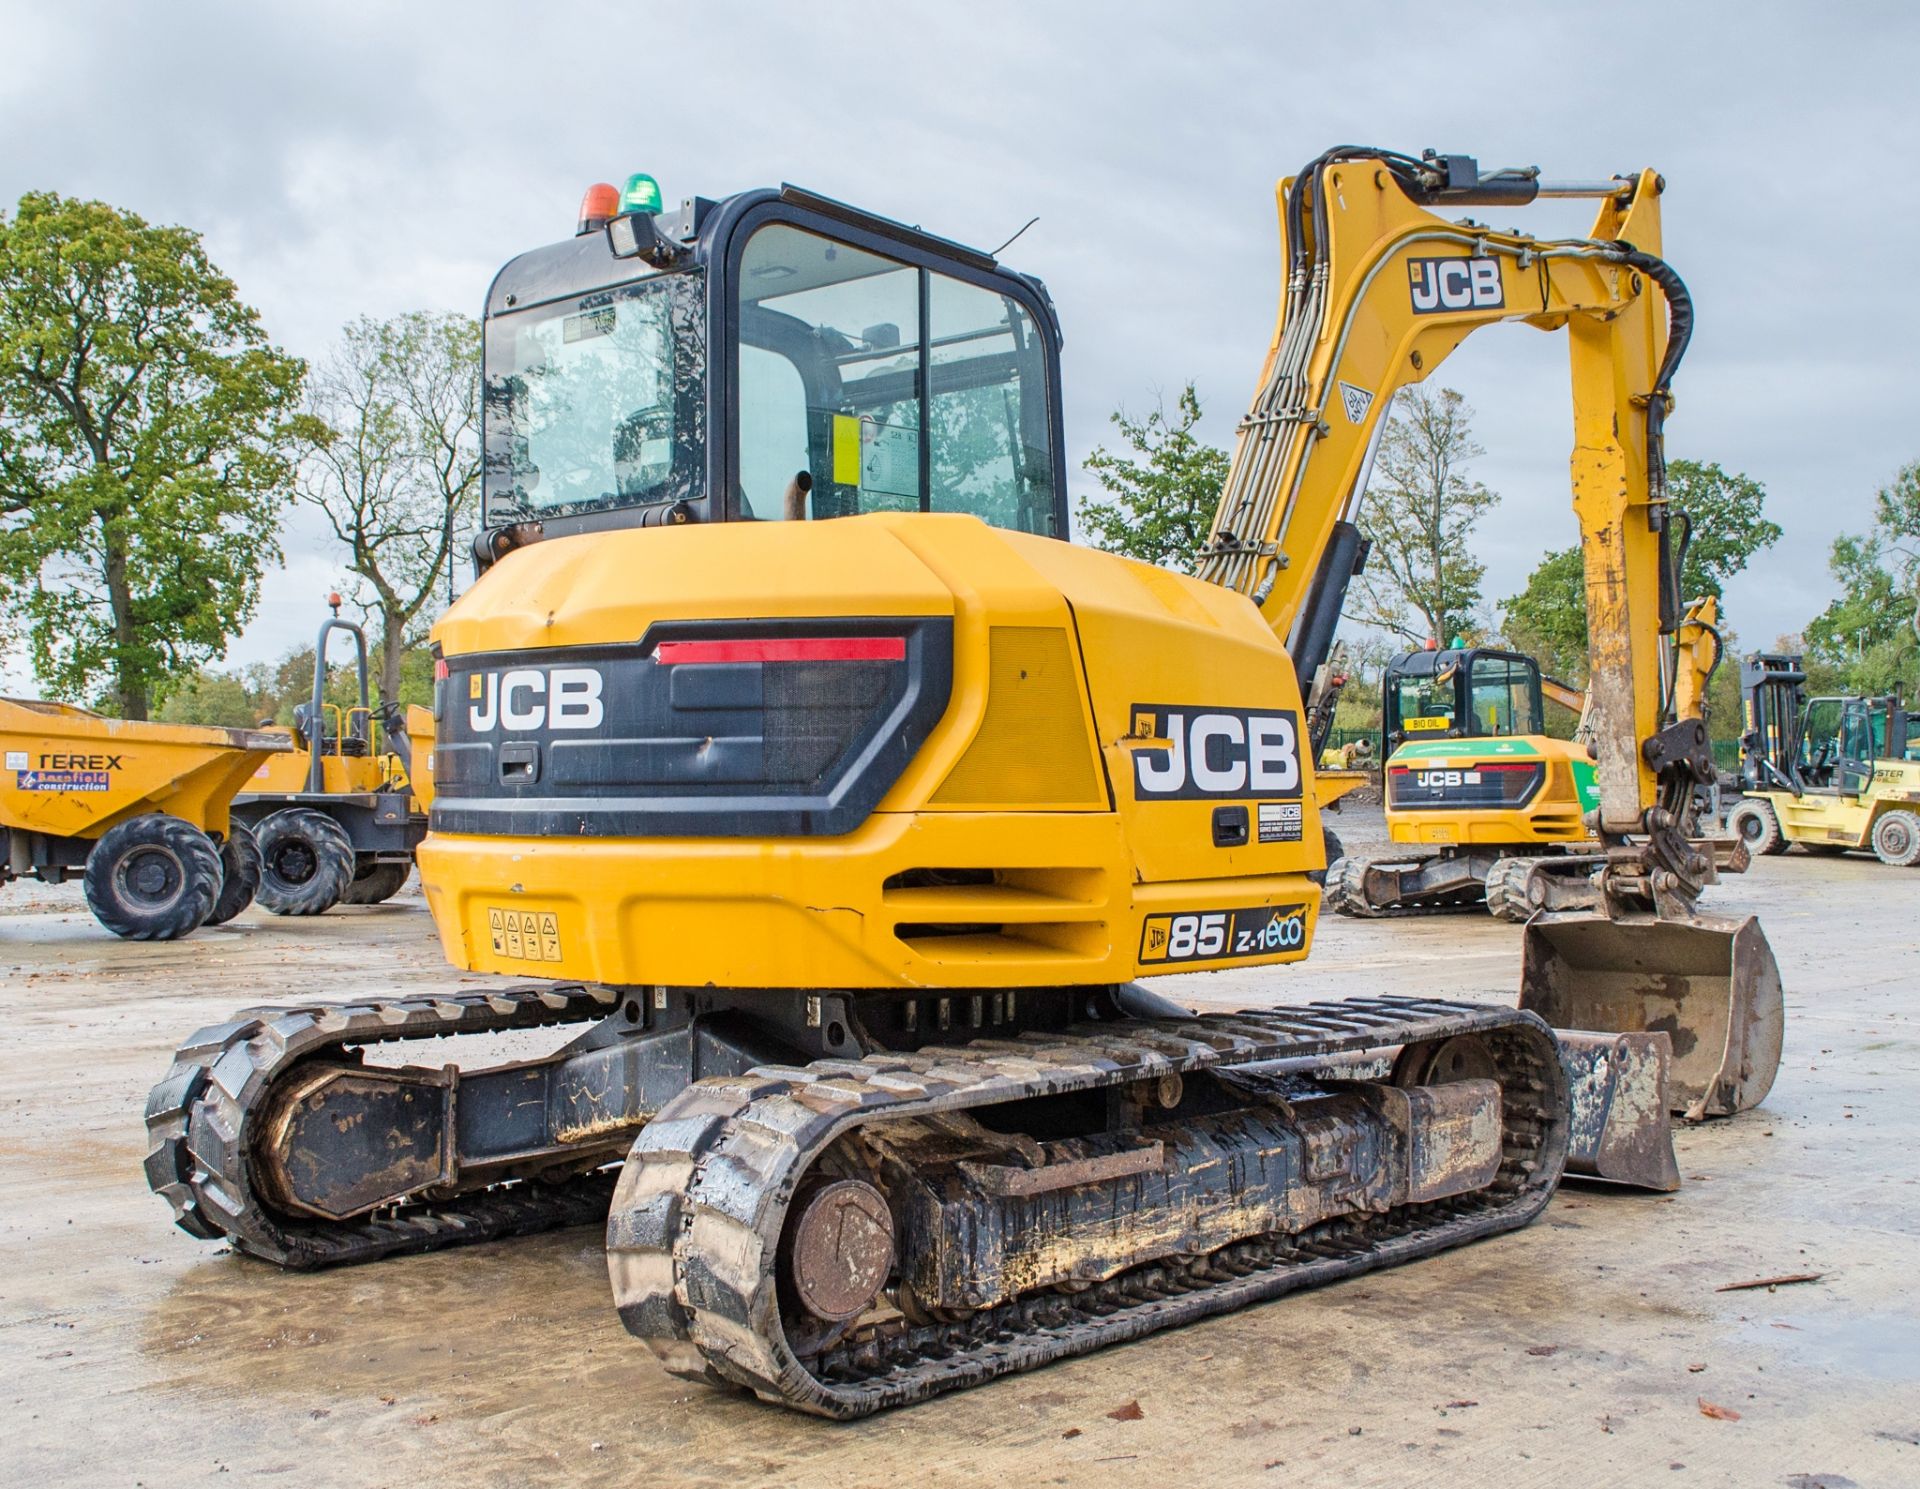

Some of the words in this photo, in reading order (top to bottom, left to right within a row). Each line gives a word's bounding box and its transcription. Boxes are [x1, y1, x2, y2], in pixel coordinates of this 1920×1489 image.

[1412, 259, 1502, 310] JCB
[469, 668, 604, 732] JCB
[39, 754, 122, 771] TEREX
[1136, 713, 1299, 792] JCB
[38, 782, 107, 791] construction
[1417, 771, 1462, 787] JCB
[1150, 929, 1166, 949] JCB
[1168, 913, 1226, 958] 85
[1235, 928, 1266, 953] Z-1
[1266, 917, 1301, 948] eco
